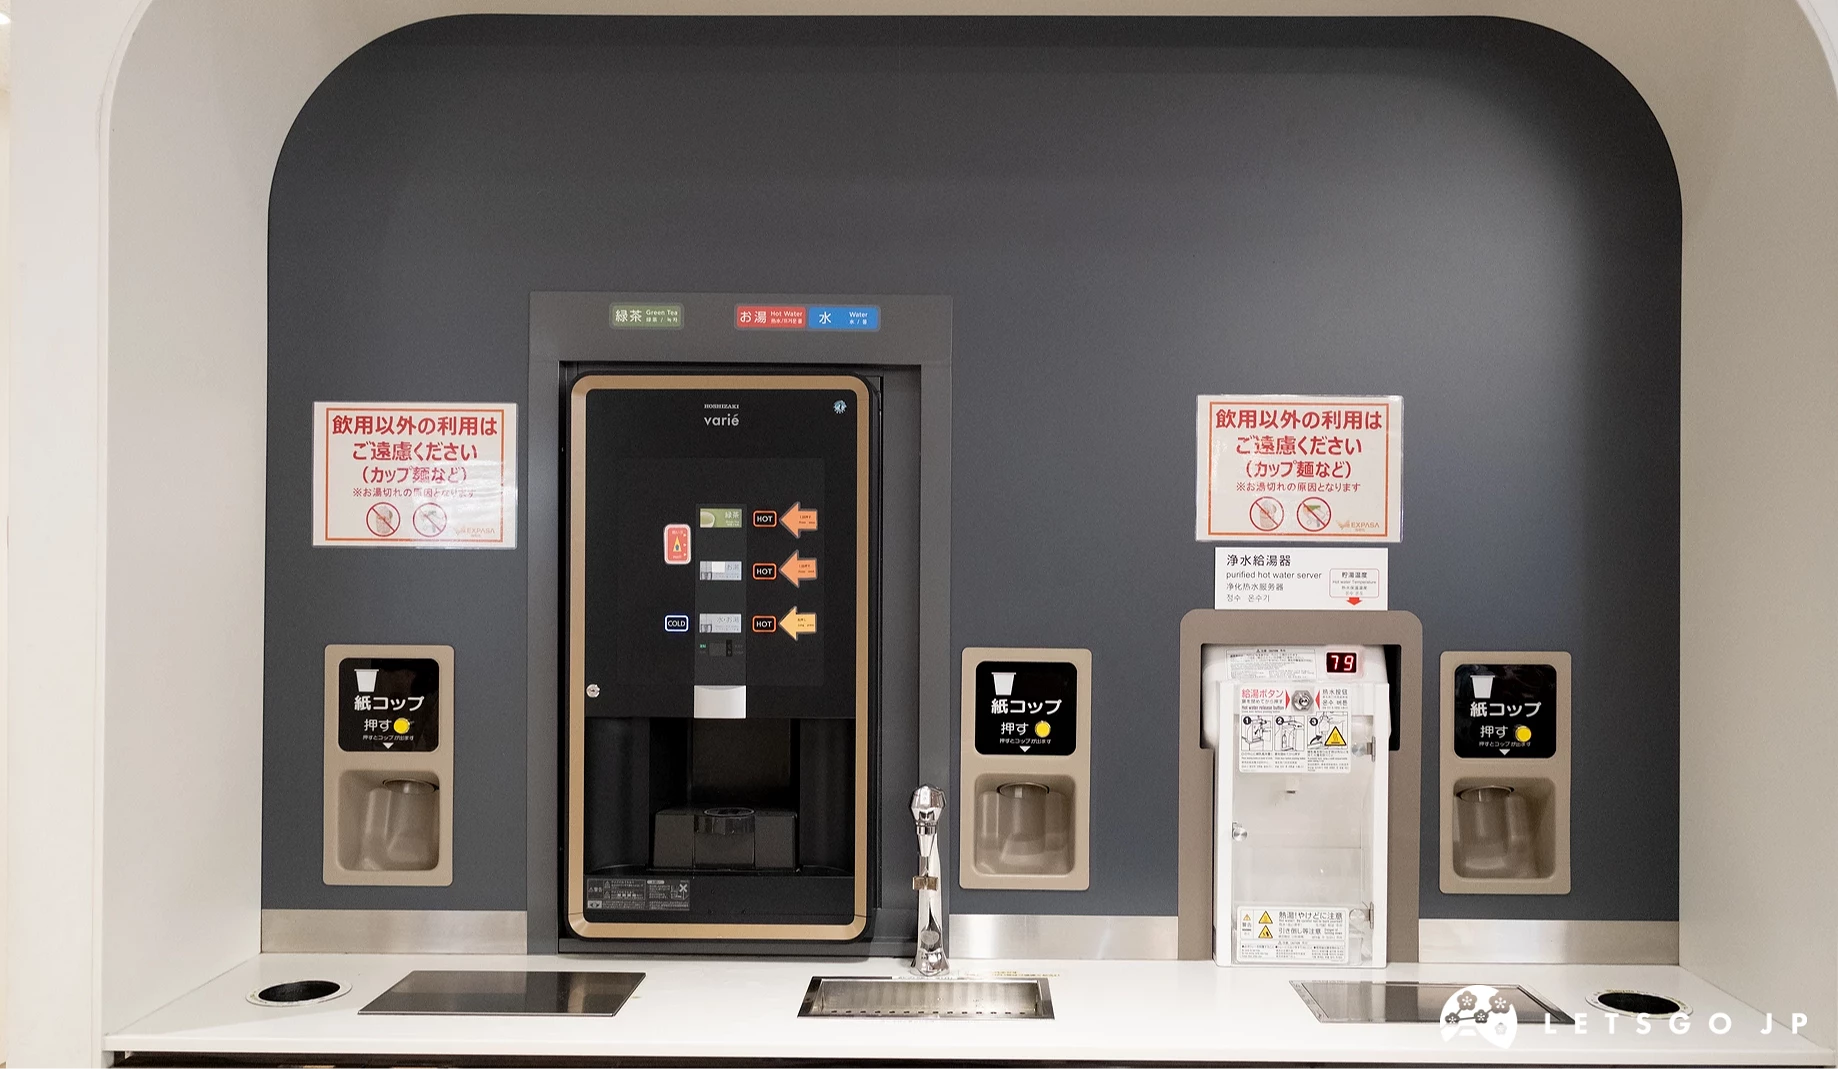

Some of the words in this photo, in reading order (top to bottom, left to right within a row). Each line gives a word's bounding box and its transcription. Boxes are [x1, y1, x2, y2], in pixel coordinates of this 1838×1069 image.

[615, 309, 642, 323] 緑茶
[740, 310, 767, 324] お湯
[818, 311, 832, 325] 水
[332, 415, 498, 436] 飲用以外の利用は
[704, 413, 740, 427] varié
[1215, 409, 1383, 430] 飲用以外の利用は
[352, 441, 479, 462] ご遠慮ください
[1235, 435, 1363, 456] ご遠慮ください
[756, 515, 773, 523] HOT
[1226, 554, 1291, 567] 浄水給湯器
[1226, 571, 1256, 580] purified
[1257, 571, 1271, 579] hot
[1272, 571, 1295, 579] water
[1297, 572, 1322, 580] server
[1226, 593, 1241, 602] 정수
[1248, 593, 1270, 602] 온수기
[667, 620, 686, 628] COLD
[756, 620, 773, 628] HOT
[1331, 655, 1355, 672] 79
[1241, 688, 1284, 699] 給湯ボタン
[354, 695, 425, 712] 紙コップ
[991, 698, 1062, 715] 紙コップ
[1470, 701, 1542, 717] 紙コップ
[364, 718, 392, 732] 押す
[1000, 721, 1029, 736] 押す
[1480, 725, 1508, 739] 押す
